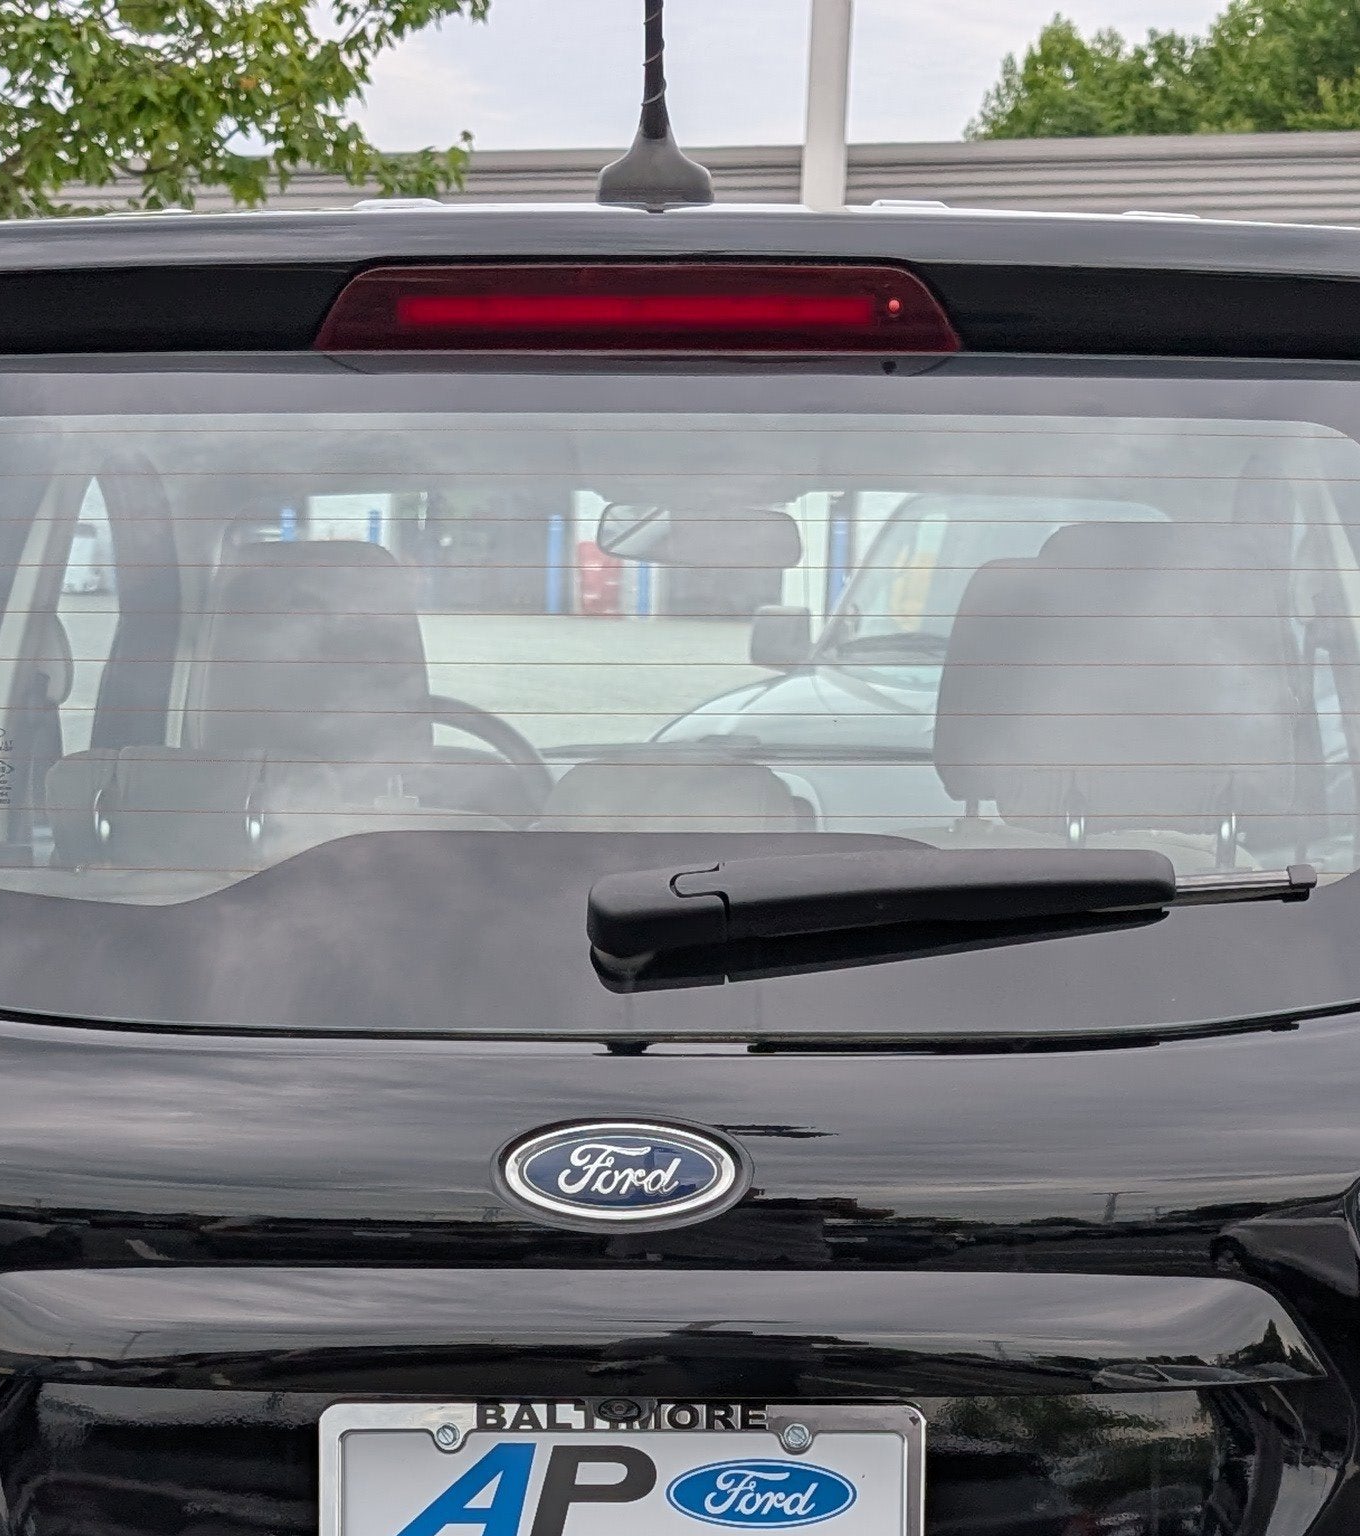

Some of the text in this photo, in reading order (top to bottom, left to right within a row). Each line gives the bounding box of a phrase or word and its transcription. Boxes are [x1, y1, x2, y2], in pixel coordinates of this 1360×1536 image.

[557, 1143, 682, 1195] Ford
[477, 1402, 768, 1430] BALTORE
[703, 1469, 816, 1516] Ford
